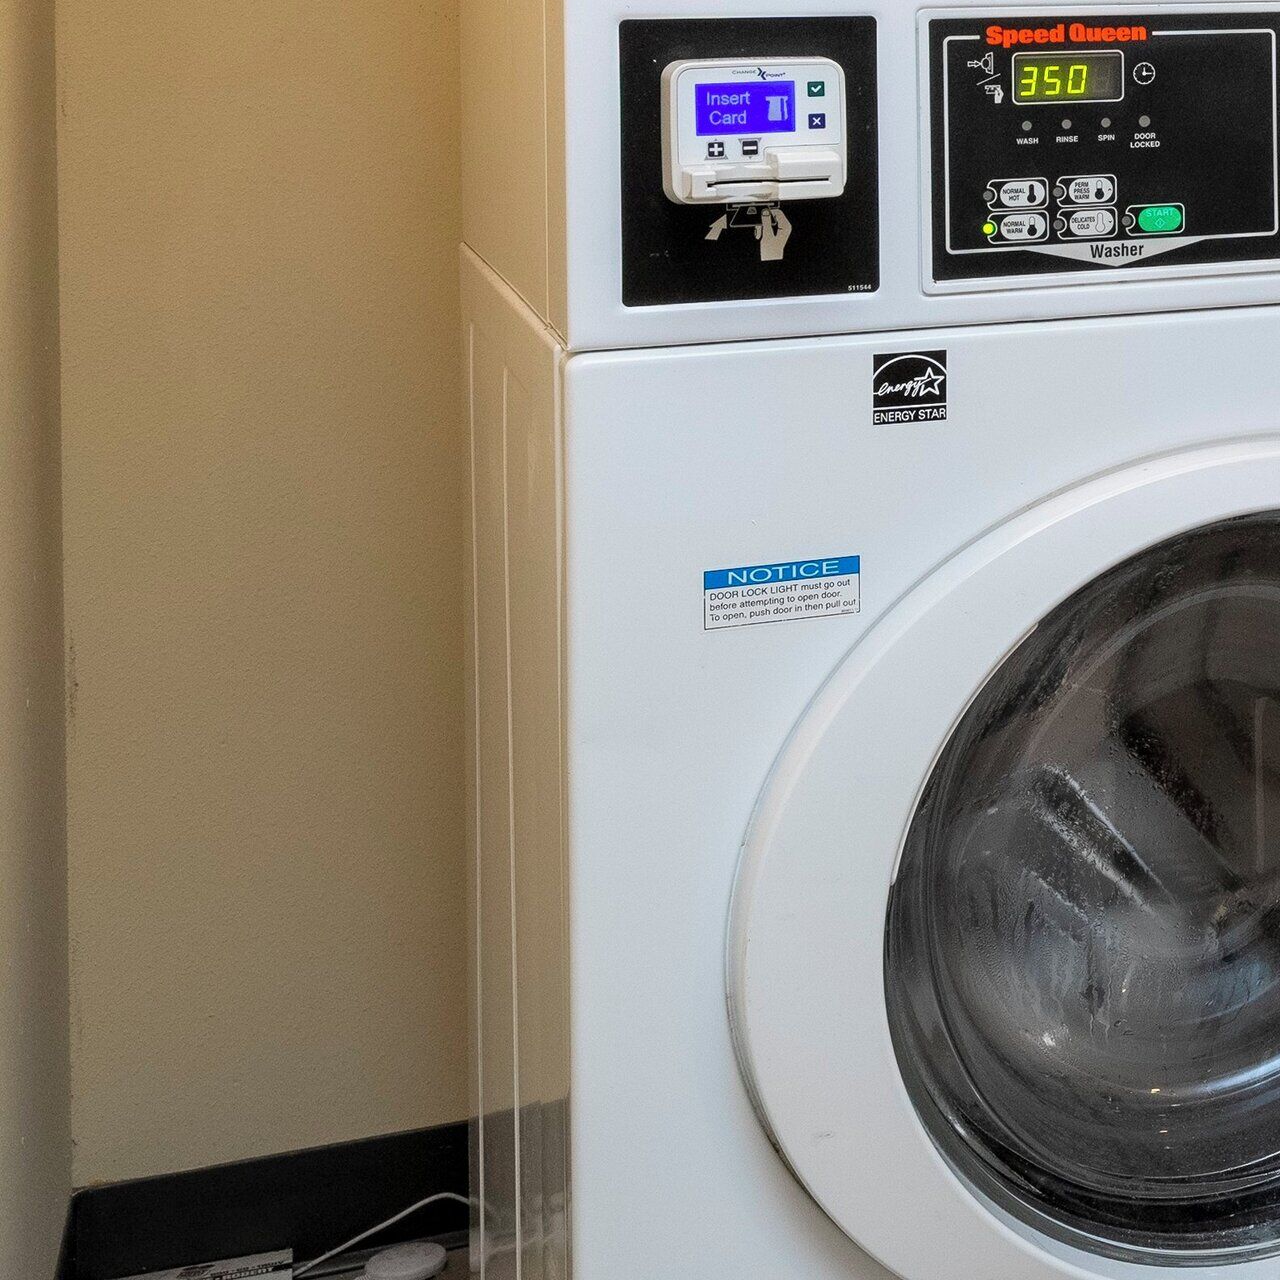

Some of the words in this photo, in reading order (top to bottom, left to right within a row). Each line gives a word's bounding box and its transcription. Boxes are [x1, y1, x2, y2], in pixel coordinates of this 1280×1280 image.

[985, 24, 1065, 48] Speed
[1069, 23, 1147, 44] Queen
[1020, 65, 1087, 96] 350
[706, 91, 750, 106] Insert
[709, 111, 747, 125] Card
[1016, 137, 1039, 145] WASH
[1056, 135, 1078, 143] RINSE
[1134, 132, 1156, 140] DOOR
[1130, 140, 1160, 148] LOCKED
[1146, 209, 1173, 217] START
[1090, 244, 1144, 259] Washer
[874, 410, 916, 423] ENERGY
[919, 408, 946, 420] STAR
[728, 560, 839, 585] NOTICE
[710, 591, 738, 600] DOOR
[742, 587, 768, 597] LOCK
[771, 584, 798, 594] LIGHT
[837, 579, 850, 587] out
[710, 603, 737, 611] before
[740, 597, 784, 608] attempting
[798, 594, 819, 602] open
[750, 609, 770, 618] push
[826, 600, 840, 609] pull
